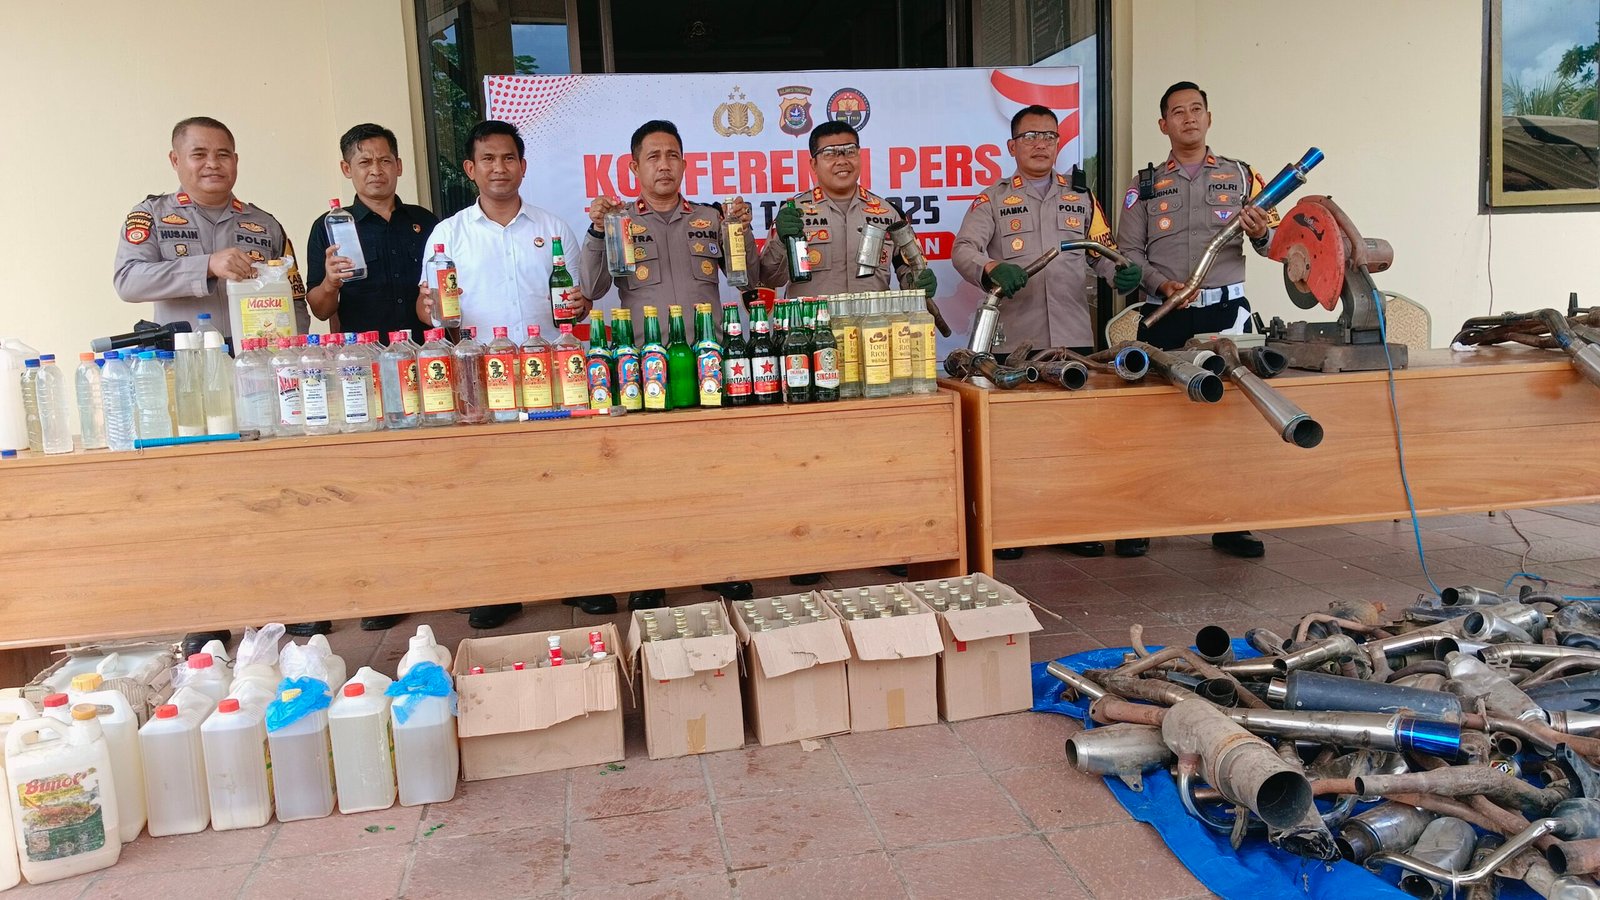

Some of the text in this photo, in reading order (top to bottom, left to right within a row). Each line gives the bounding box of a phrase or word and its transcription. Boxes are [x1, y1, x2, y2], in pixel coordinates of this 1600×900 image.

[583, 144, 1003, 199] KOFERENI PERS
[1154, 187, 1179, 198] UBHAN
[1000, 206, 1029, 217] HAMKA
[1058, 204, 1085, 214] POLRI
[865, 216, 893, 226] POLRI
[160, 230, 199, 240] HUSAIN
[631, 234, 654, 243] TRA
[688, 230, 717, 240] POLRI
[236, 234, 272, 248] POLRI
[247, 297, 282, 309] Masku
